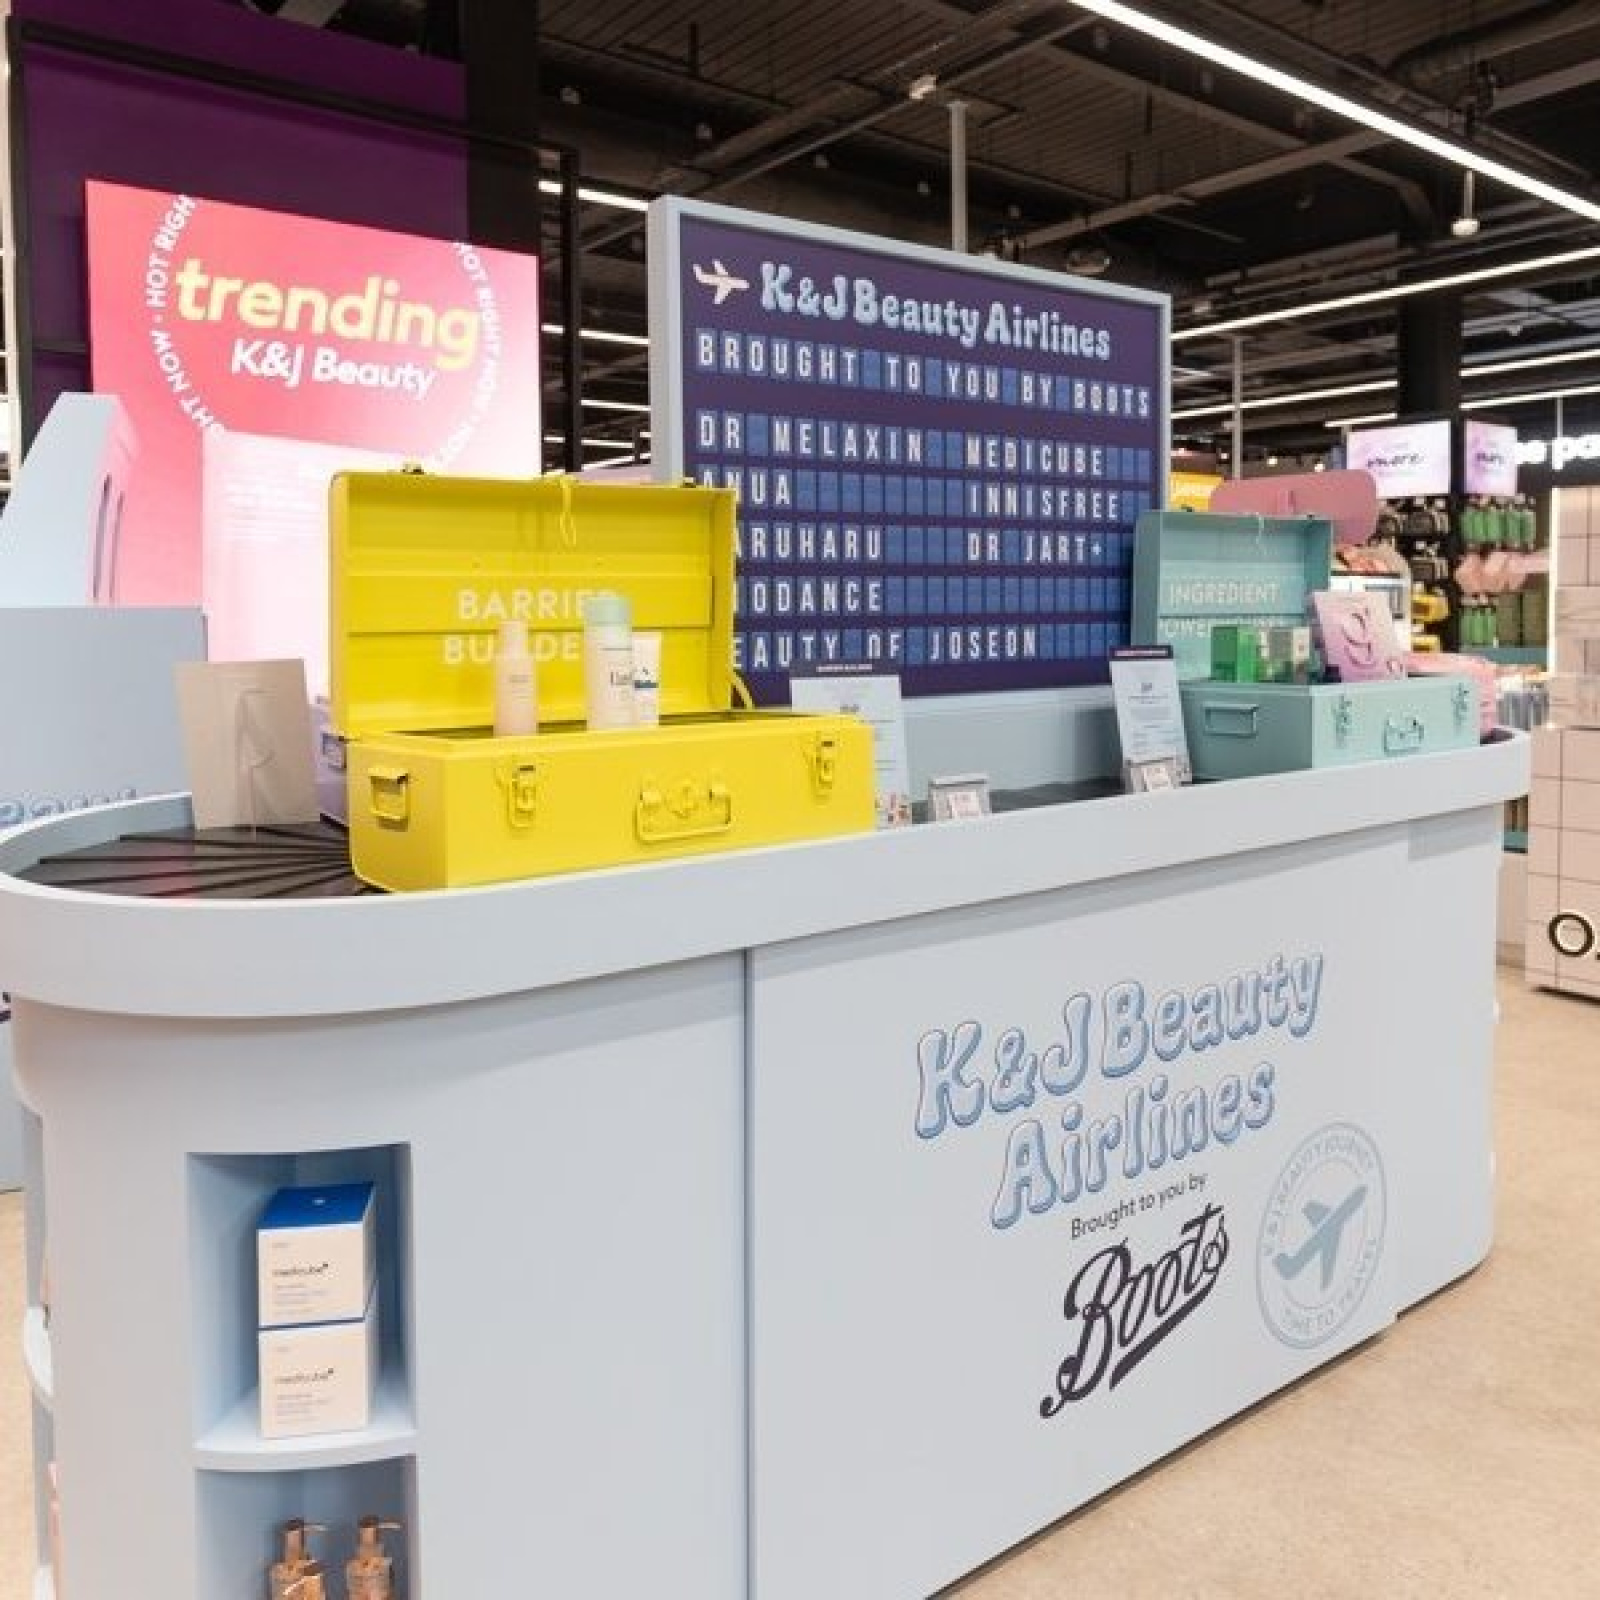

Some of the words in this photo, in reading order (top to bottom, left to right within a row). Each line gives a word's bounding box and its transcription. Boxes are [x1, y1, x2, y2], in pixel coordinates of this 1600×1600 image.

[154, 194, 196, 251] RIGH
[146, 253, 169, 307] HOT
[176, 258, 481, 370] trending
[761, 262, 853, 319] K&J
[854, 279, 981, 348] Beauty
[984, 303, 1112, 360] Airlines
[150, 330, 192, 392] NOW
[231, 339, 305, 388] K&J
[311, 347, 436, 399] Beauty
[699, 334, 858, 382] BROUGHT
[887, 358, 921, 391] TO
[946, 365, 998, 398] YOU
[1021, 375, 1052, 403] BY
[1074, 383, 1150, 417] BOOTS
[700, 415, 741, 448] DR
[774, 422, 922, 459] MELAXIN
[968, 435, 1104, 474] MEDICUBE
[971, 485, 1118, 518] INNISFREE
[733, 528, 882, 560] ARUHARU
[968, 533, 1000, 561] DR
[457, 588, 618, 620] BARRIE
[733, 581, 881, 613] IODANCE
[442, 632, 581, 665] BUDE
[733, 634, 838, 668] EAUTY
[931, 629, 1037, 660] JOSEON
[1547, 912, 1600, 961] O
[915, 992, 1092, 1140] K&J
[1100, 954, 1324, 1079] Beauty
[990, 1062, 1277, 1230] Airlines
[1071, 1199, 1136, 1240] Brought
[1138, 1194, 1155, 1212] to
[1158, 1180, 1185, 1210] you
[1188, 1172, 1208, 1193] by
[1039, 1202, 1230, 1419] Boots
